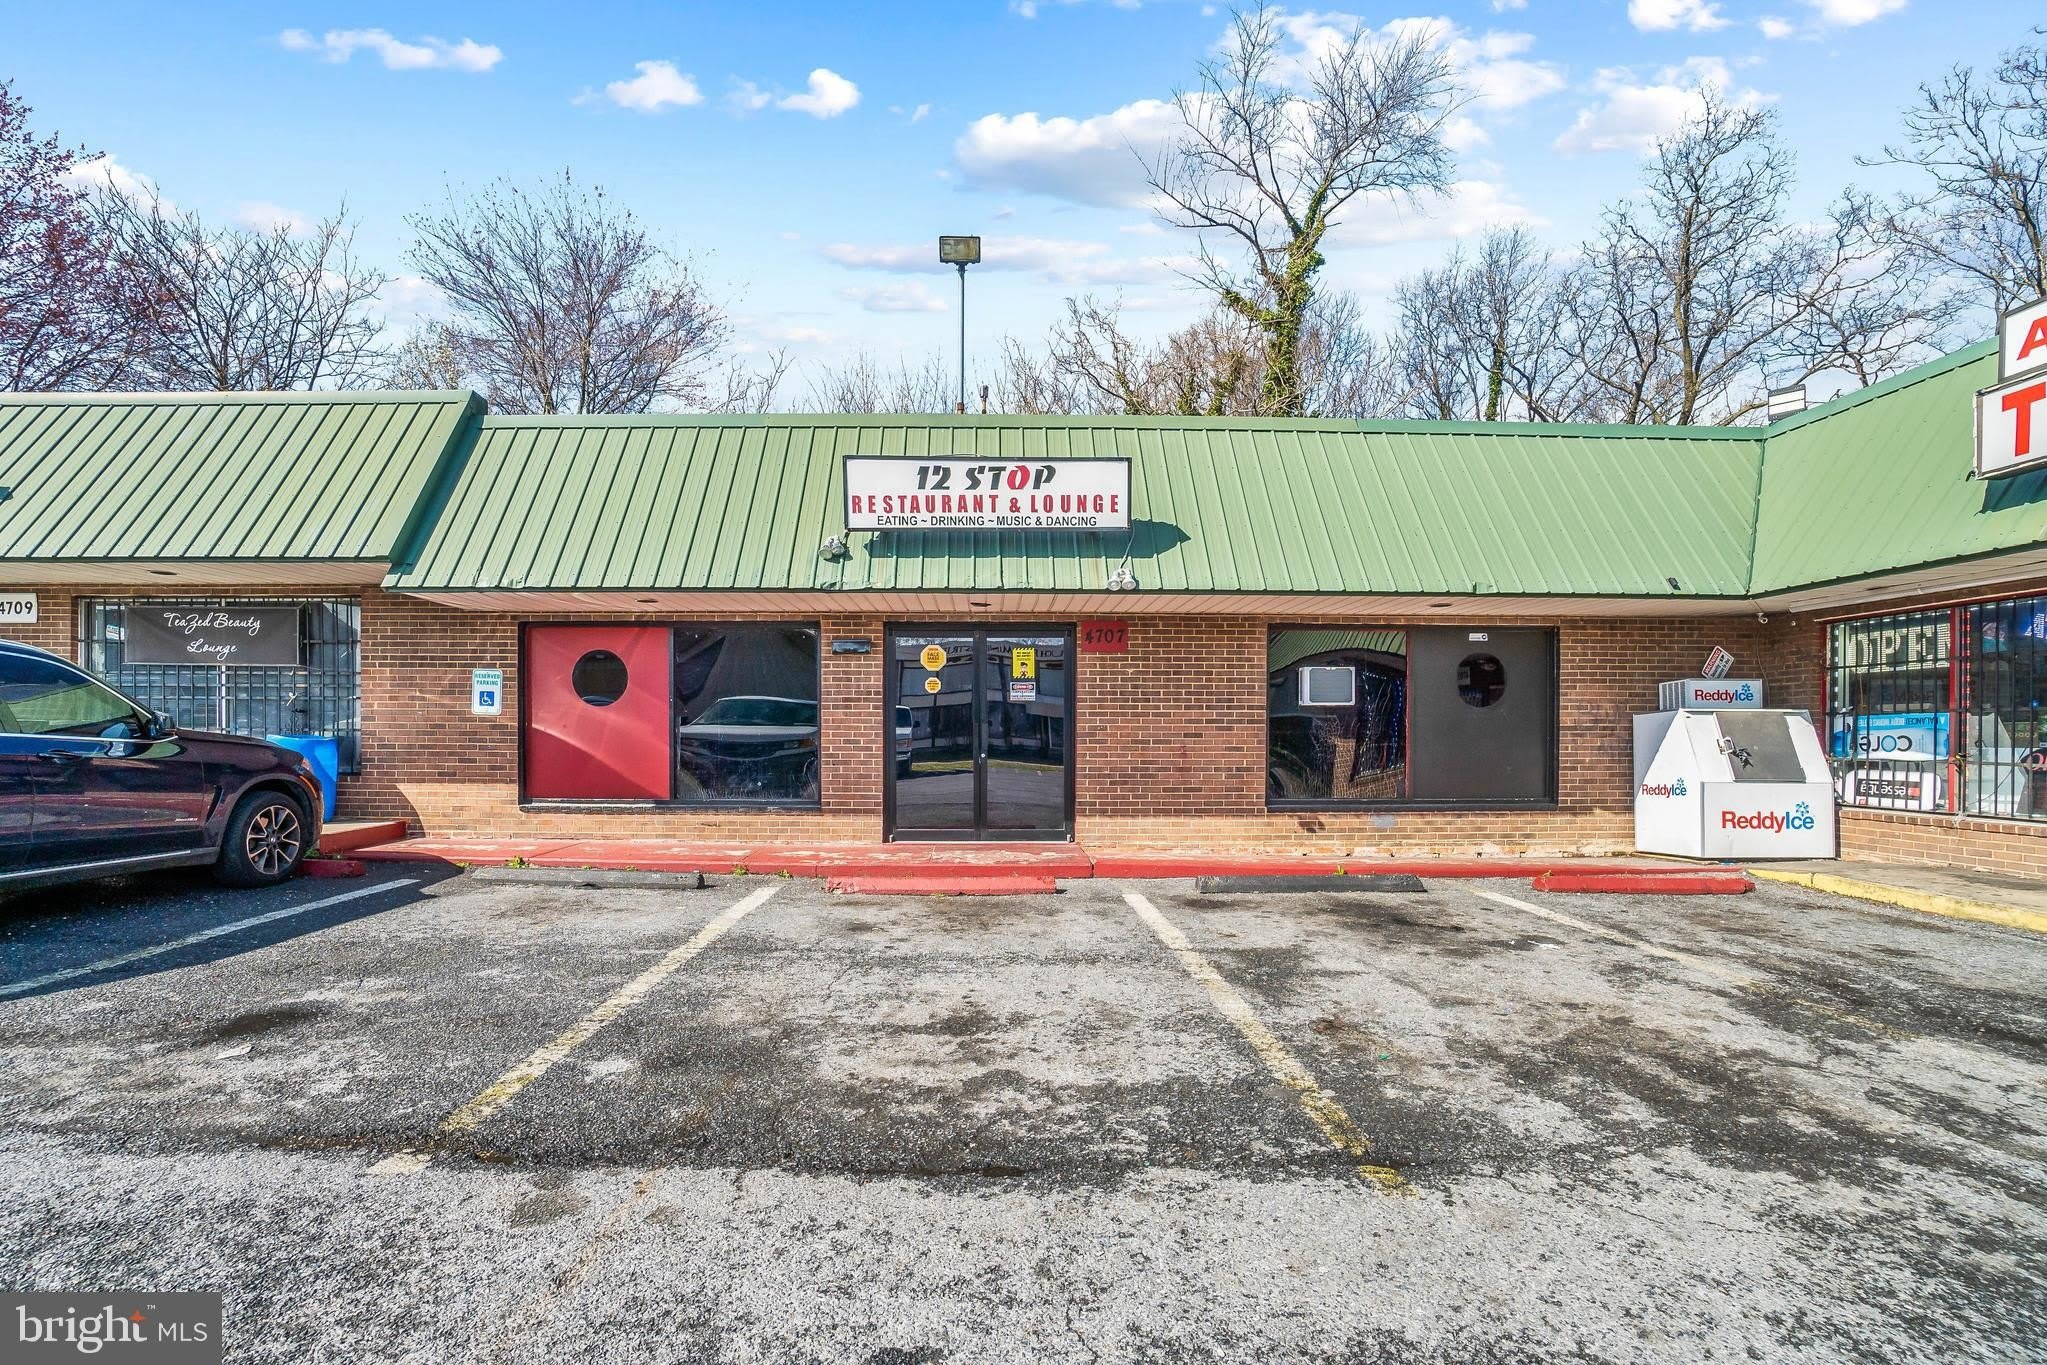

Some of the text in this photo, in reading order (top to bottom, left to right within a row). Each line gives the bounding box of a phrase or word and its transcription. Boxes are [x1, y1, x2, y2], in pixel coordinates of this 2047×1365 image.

[917, 464, 1056, 490] 12 STOP
[851, 494, 1120, 513] RESTAURANT & LOUNGE
[877, 515, 919, 526] EATING
[930, 515, 985, 526] DRINKING
[996, 516, 1032, 526] MUSIC
[1034, 516, 1043, 526] &
[1046, 516, 1098, 526] DANCING
[0, 601, 33, 615] 4709
[213, 612, 260, 636] Beauty
[1085, 629, 1125, 644] 4707
[186, 638, 237, 660] Lounge
[1694, 689, 1754, 703] ReddyIce
[1859, 735, 1913, 752] core
[1641, 783, 1687, 798] ReddyIce
[1860, 784, 1906, 796] essenta
[1721, 811, 1815, 833] ReddyIce
